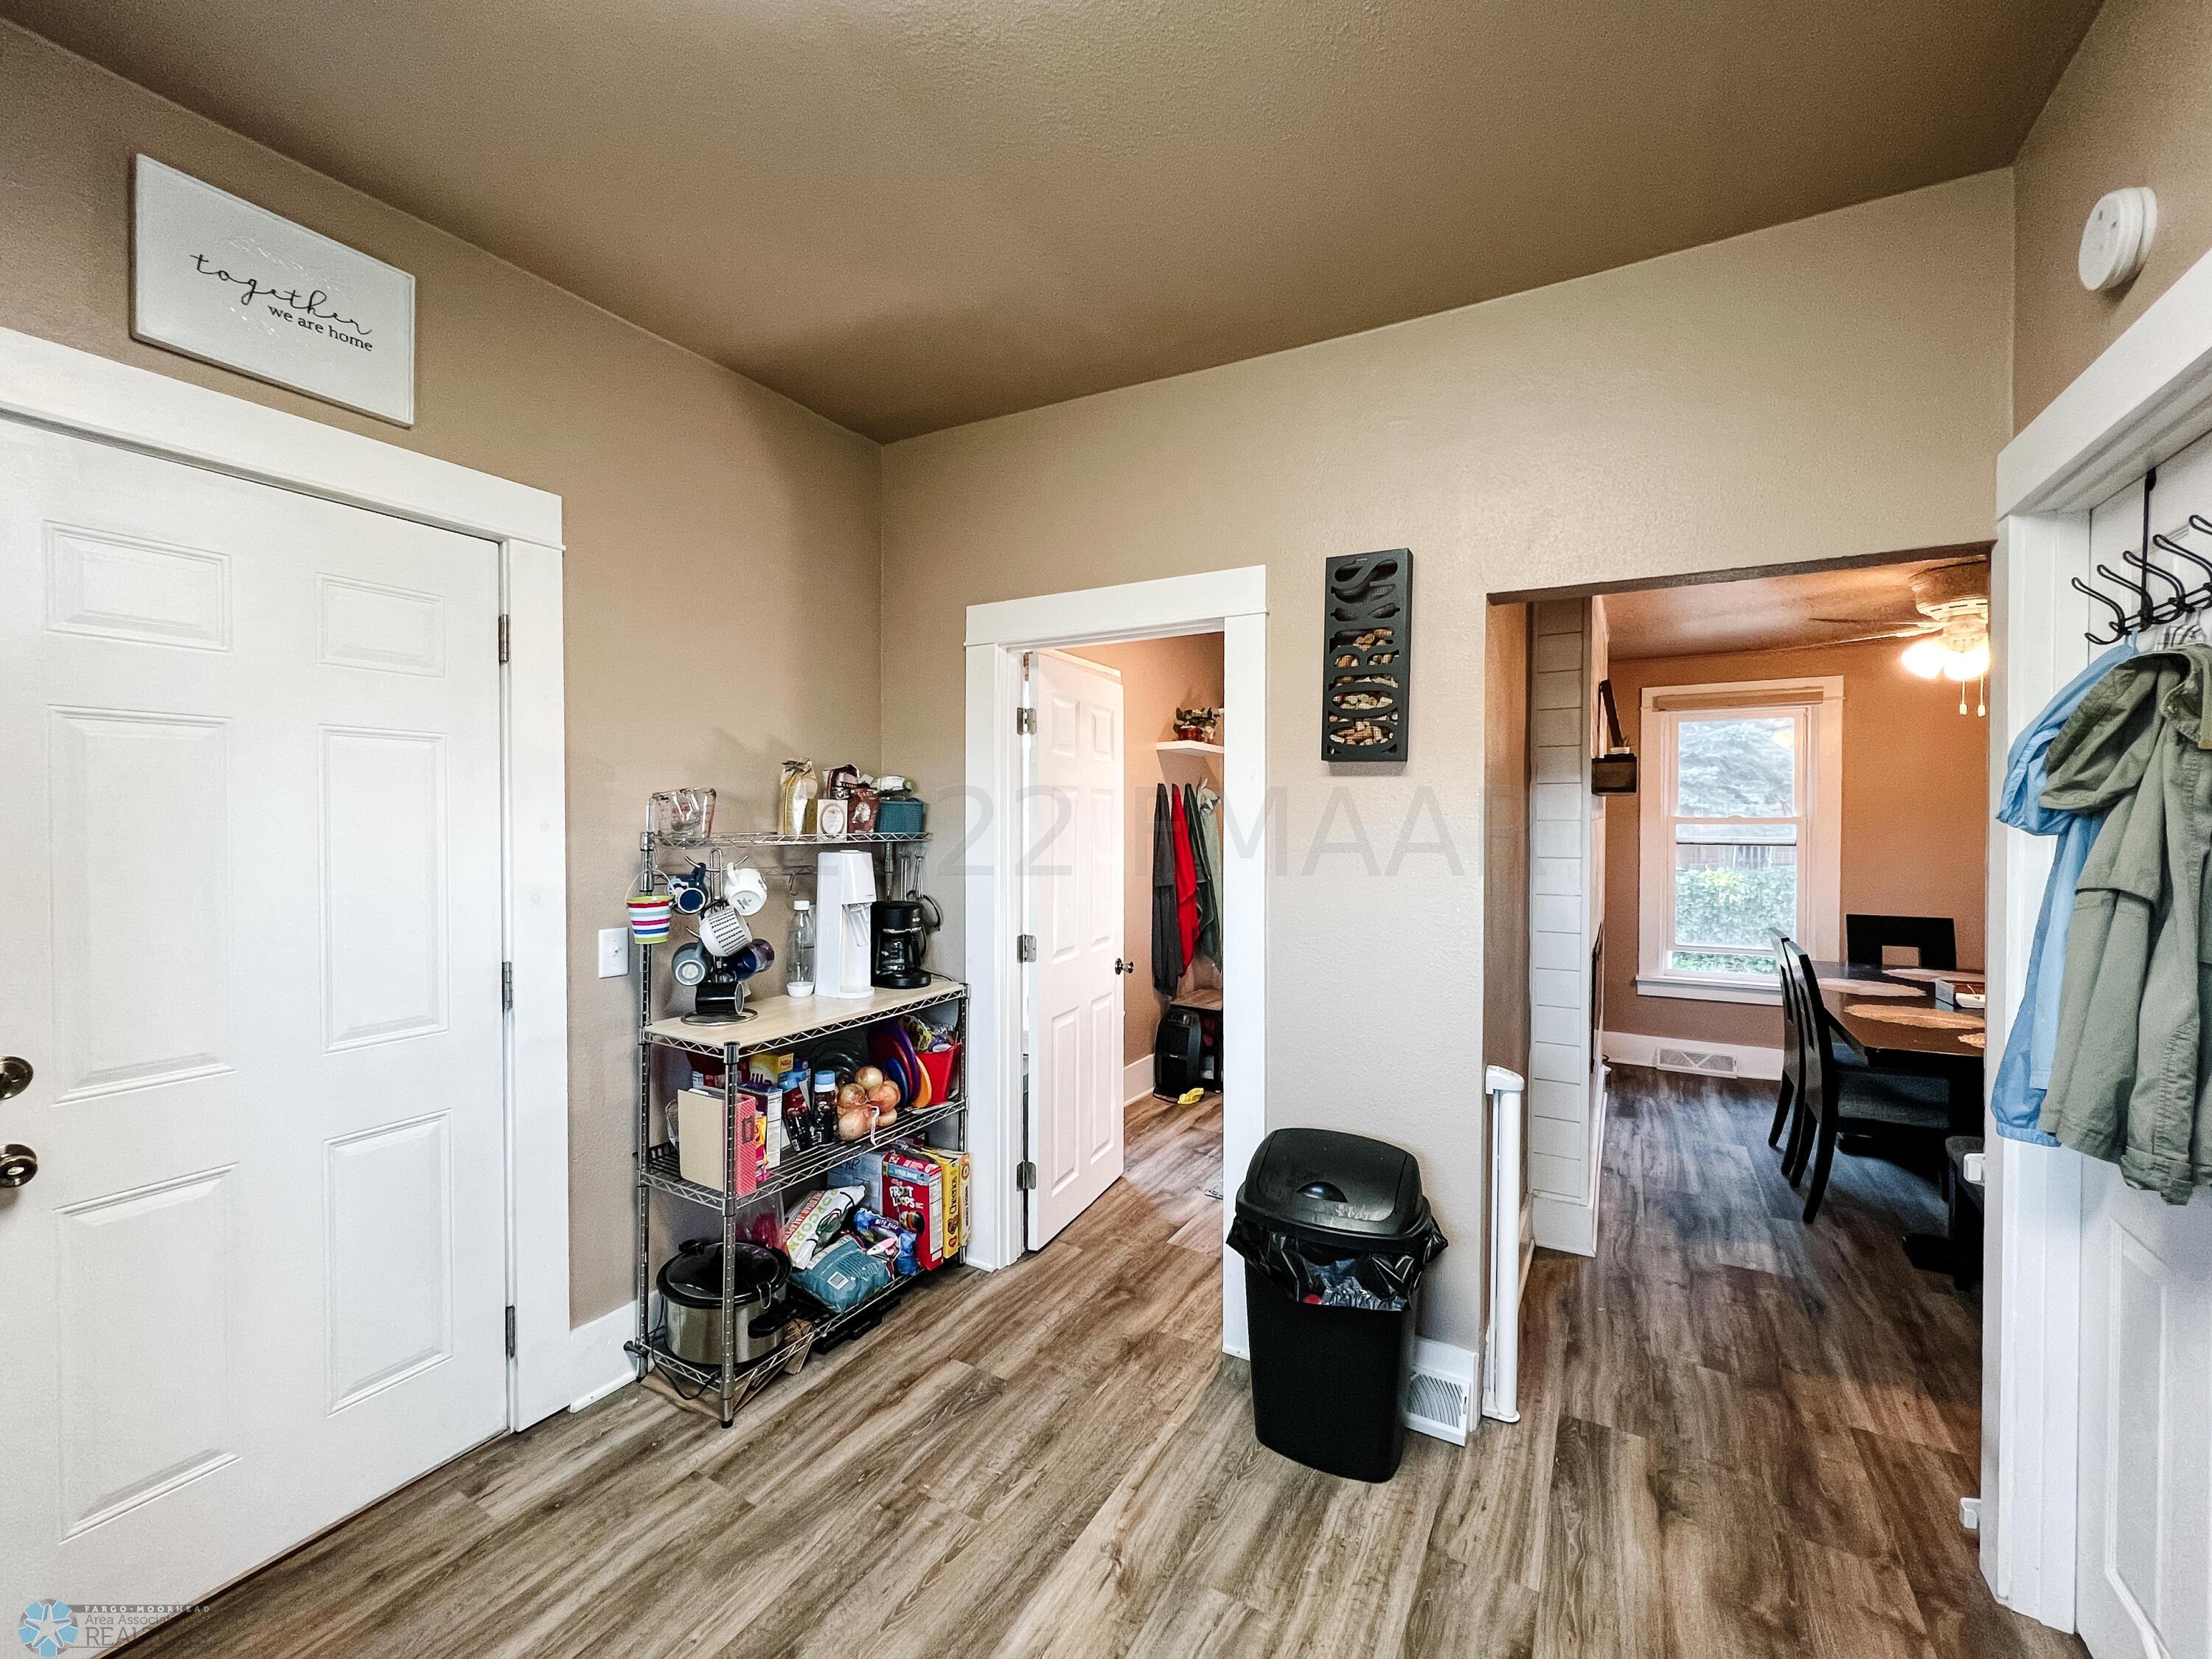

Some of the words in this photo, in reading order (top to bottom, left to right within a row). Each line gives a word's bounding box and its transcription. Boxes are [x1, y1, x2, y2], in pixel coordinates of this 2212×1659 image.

[189, 254, 372, 335] together
[268, 305, 293, 322] we
[298, 317, 324, 334] are
[329, 325, 373, 352] home
[888, 1186, 914, 1197] FROOT
[892, 1196, 916, 1209] LOOPS
[949, 1176, 958, 1215] Cheerios
